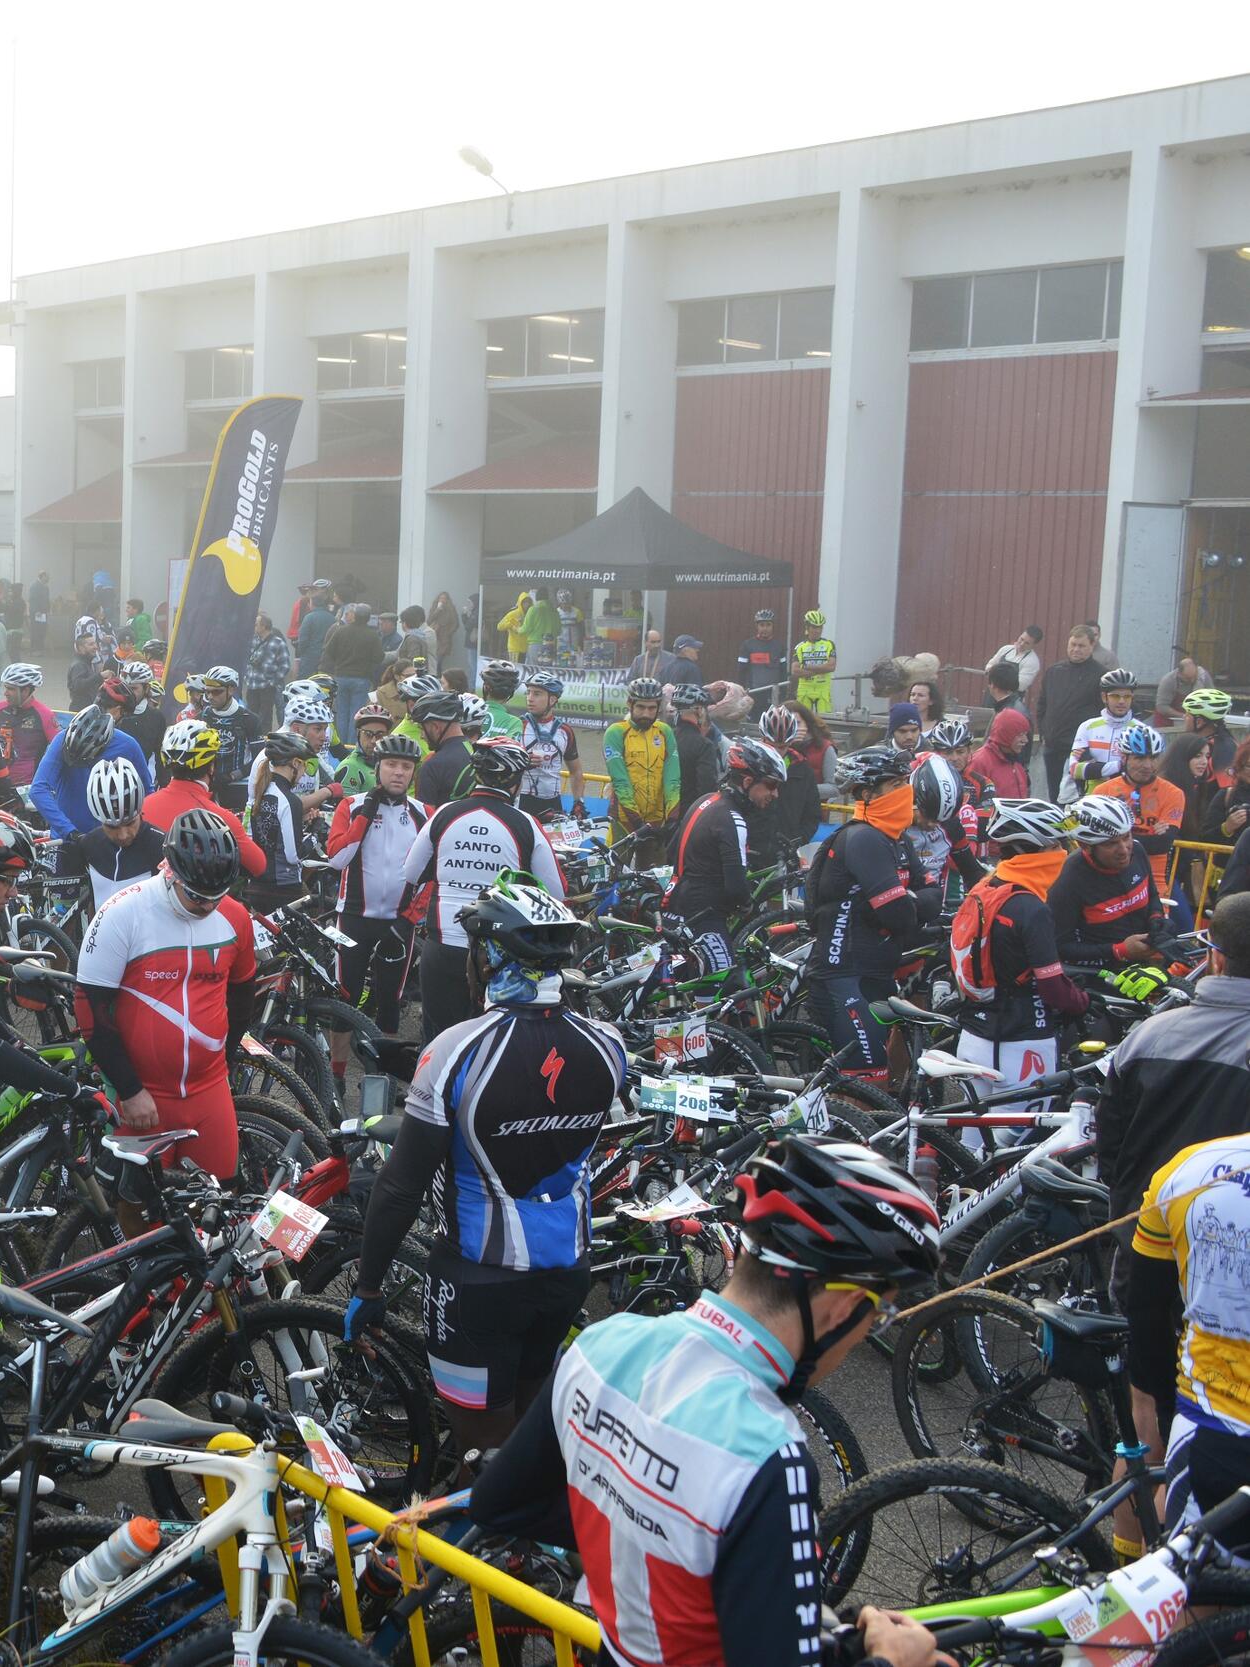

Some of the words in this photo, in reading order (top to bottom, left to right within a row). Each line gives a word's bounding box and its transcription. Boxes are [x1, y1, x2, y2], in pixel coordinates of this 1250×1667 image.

[226, 429, 267, 556] PROGOLD
[248, 442, 279, 560] LUBRICANTS
[506, 568, 617, 583] www.nutrimania.pt
[675, 572, 770, 583] www.nutrimania.pt
[468, 825, 489, 836] GD
[563, 830, 581, 840] 508
[454, 840, 501, 854] SANTO
[42, 877, 81, 887] MERIDA
[144, 969, 179, 982] speed
[685, 1033, 705, 1051] 606
[679, 1094, 708, 1113] 208
[491, 1111, 604, 1137] SPECIALIZED
[892, 1212, 927, 1247] GIRO
[423, 1272, 432, 1337] FOCUS
[332, 1449, 355, 1477] 102
[1144, 1588, 1187, 1645] 265
[1071, 1621, 1097, 1641] 2015
